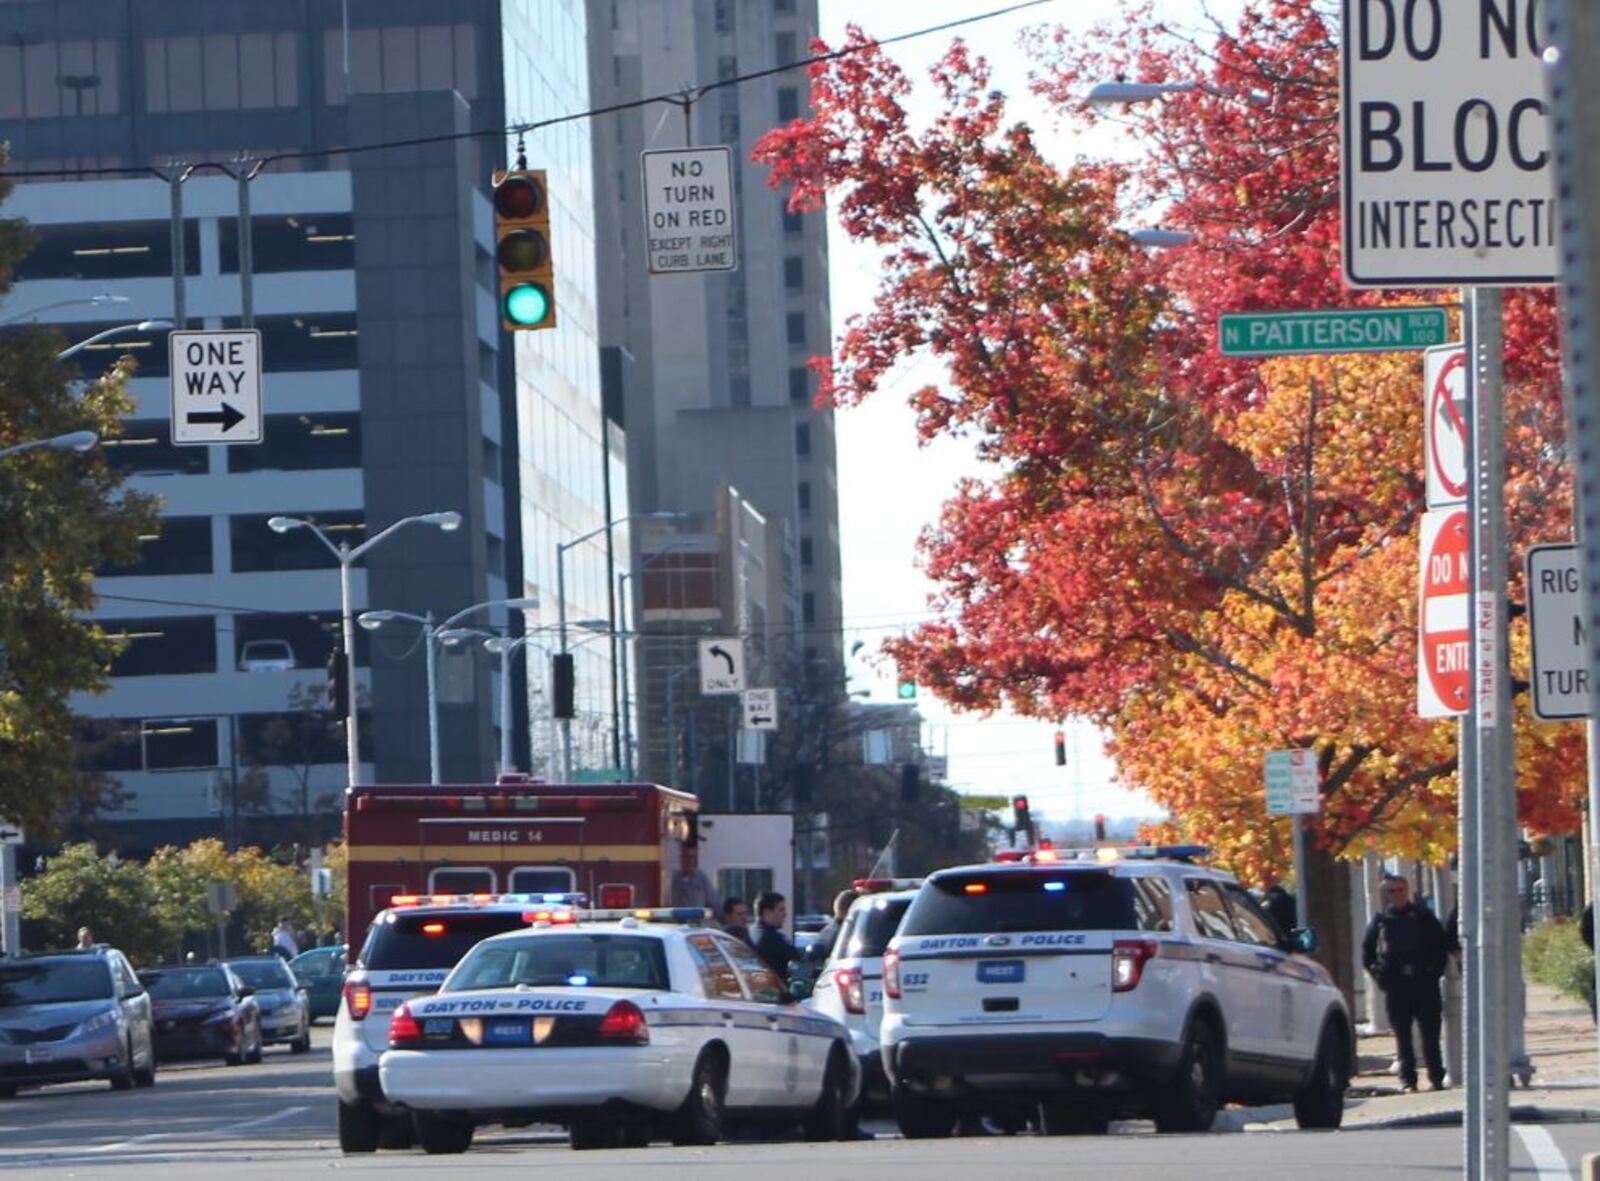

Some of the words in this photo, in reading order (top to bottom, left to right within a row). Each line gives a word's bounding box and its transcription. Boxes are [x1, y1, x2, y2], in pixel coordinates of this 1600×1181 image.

[1359, 0, 1441, 61] DO
[1360, 98, 1550, 172] BLOC
[671, 160, 703, 178] NO
[663, 185, 715, 203] TURN
[653, 211, 679, 229] ON
[688, 209, 727, 227] RED
[650, 236, 691, 252] EXCEPT
[700, 235, 732, 249] RIGHT
[658, 254, 688, 267] CURB
[697, 252, 728, 266] LANE
[1226, 328, 1239, 344] N
[1250, 317, 1401, 345] PATTERSON
[1409, 314, 1439, 328] BLVD
[187, 341, 244, 366] ONE
[185, 370, 245, 396] WAY
[1432, 553, 1452, 585] DO
[1541, 568, 1579, 594] RIG
[707, 678, 738, 691] ONLY
[468, 831, 518, 842] MEDIC
[528, 831, 542, 843] 14
[919, 937, 978, 950] DAYTON
[1021, 934, 1087, 946] POLICE
[388, 973, 446, 982] DAYTON
[424, 1000, 496, 1014] DAYTON
[517, 999, 586, 1011] POLICE
